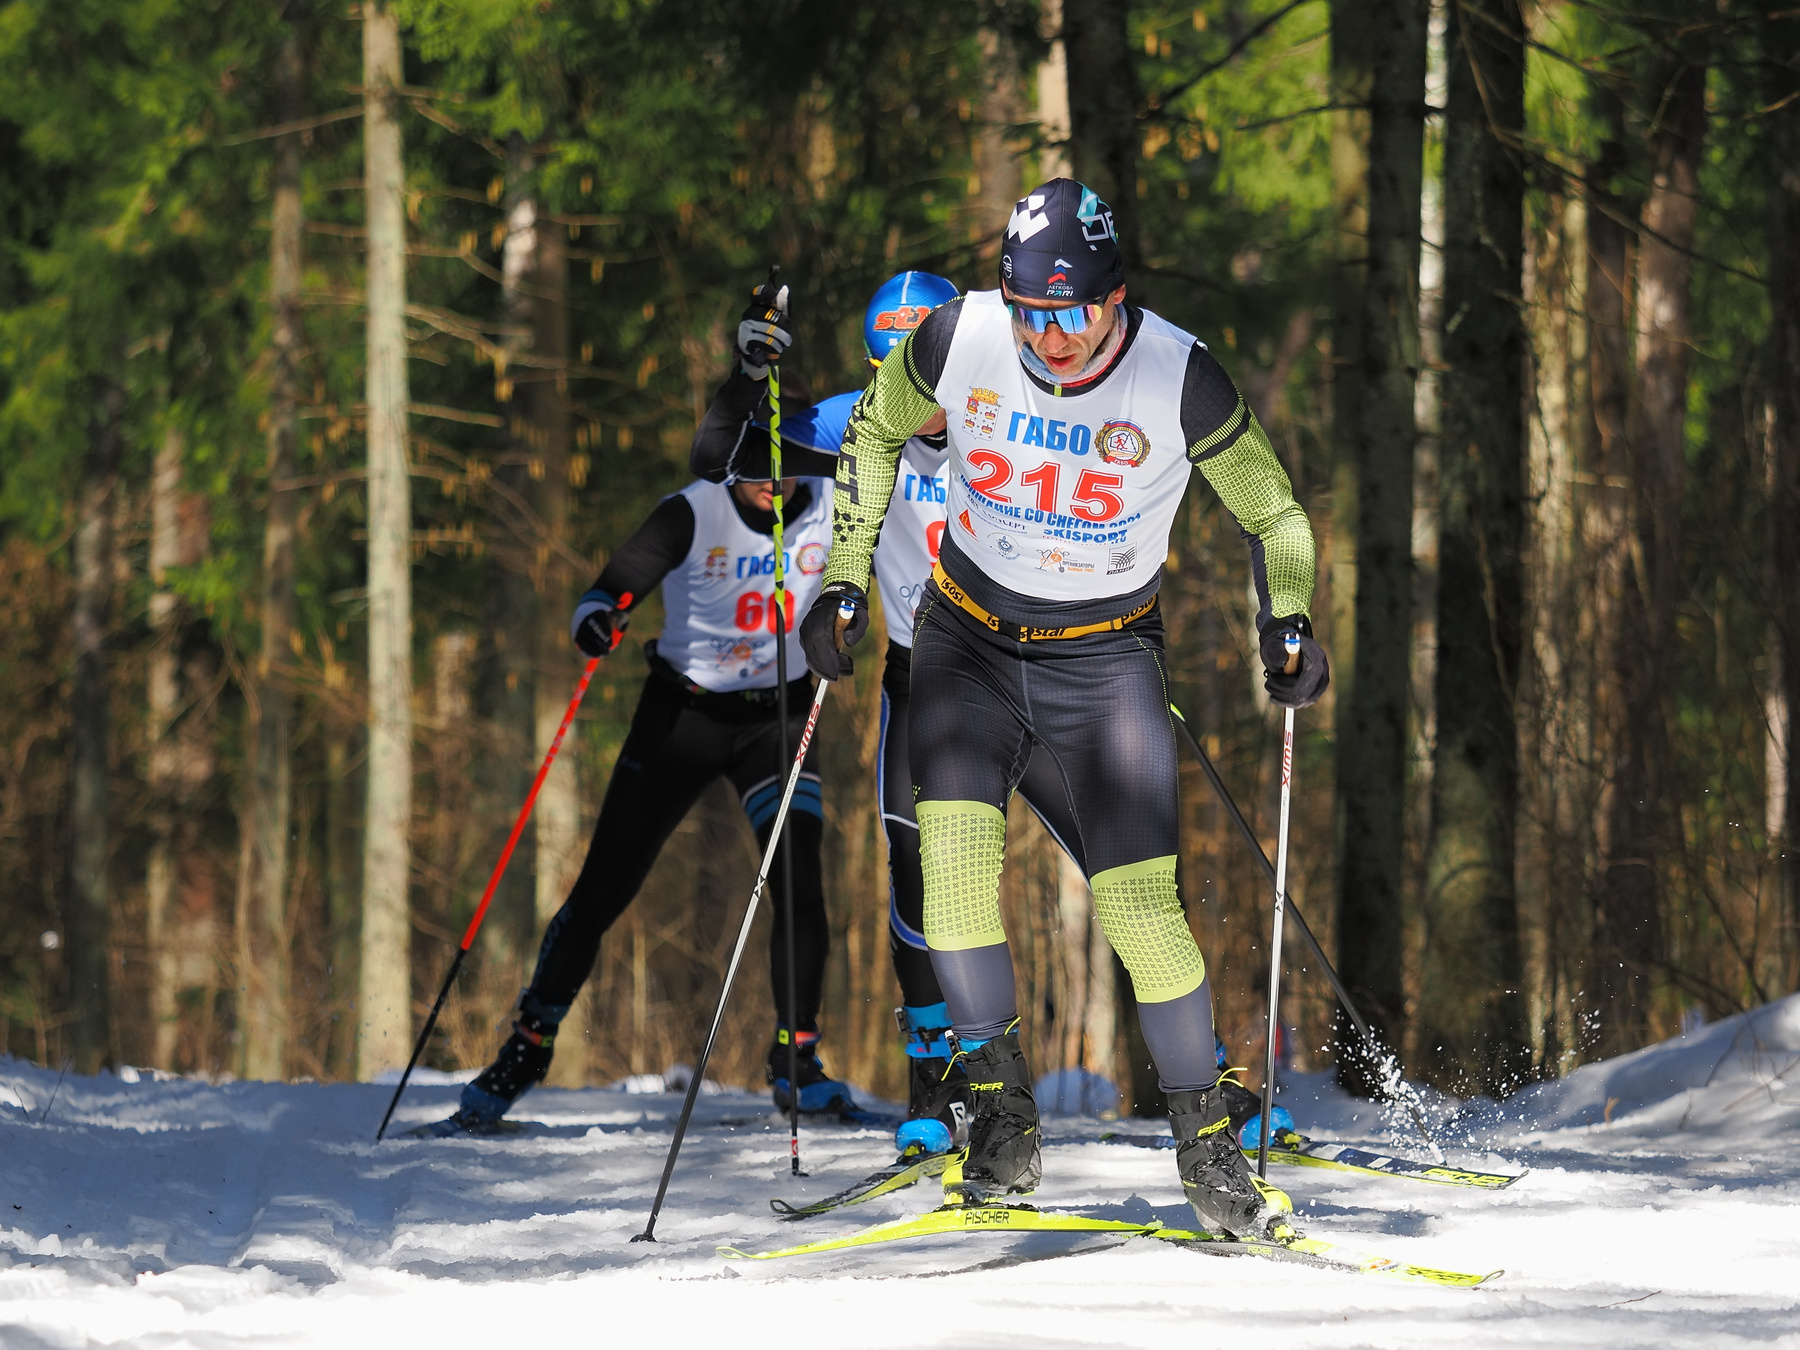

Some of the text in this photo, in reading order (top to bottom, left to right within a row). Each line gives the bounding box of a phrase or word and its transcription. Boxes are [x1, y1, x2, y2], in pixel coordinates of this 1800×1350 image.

[1046, 289, 1073, 297] PARI
[1006, 410, 1091, 456] ГАБО
[966, 447, 1125, 522] 215
[1024, 507, 1045, 524] СО
[734, 590, 795, 635] 60
[917, 1156, 947, 1177] FISCHER
[964, 1210, 1011, 1226] FISCHER
[1247, 1244, 1273, 1255] FISCHER
